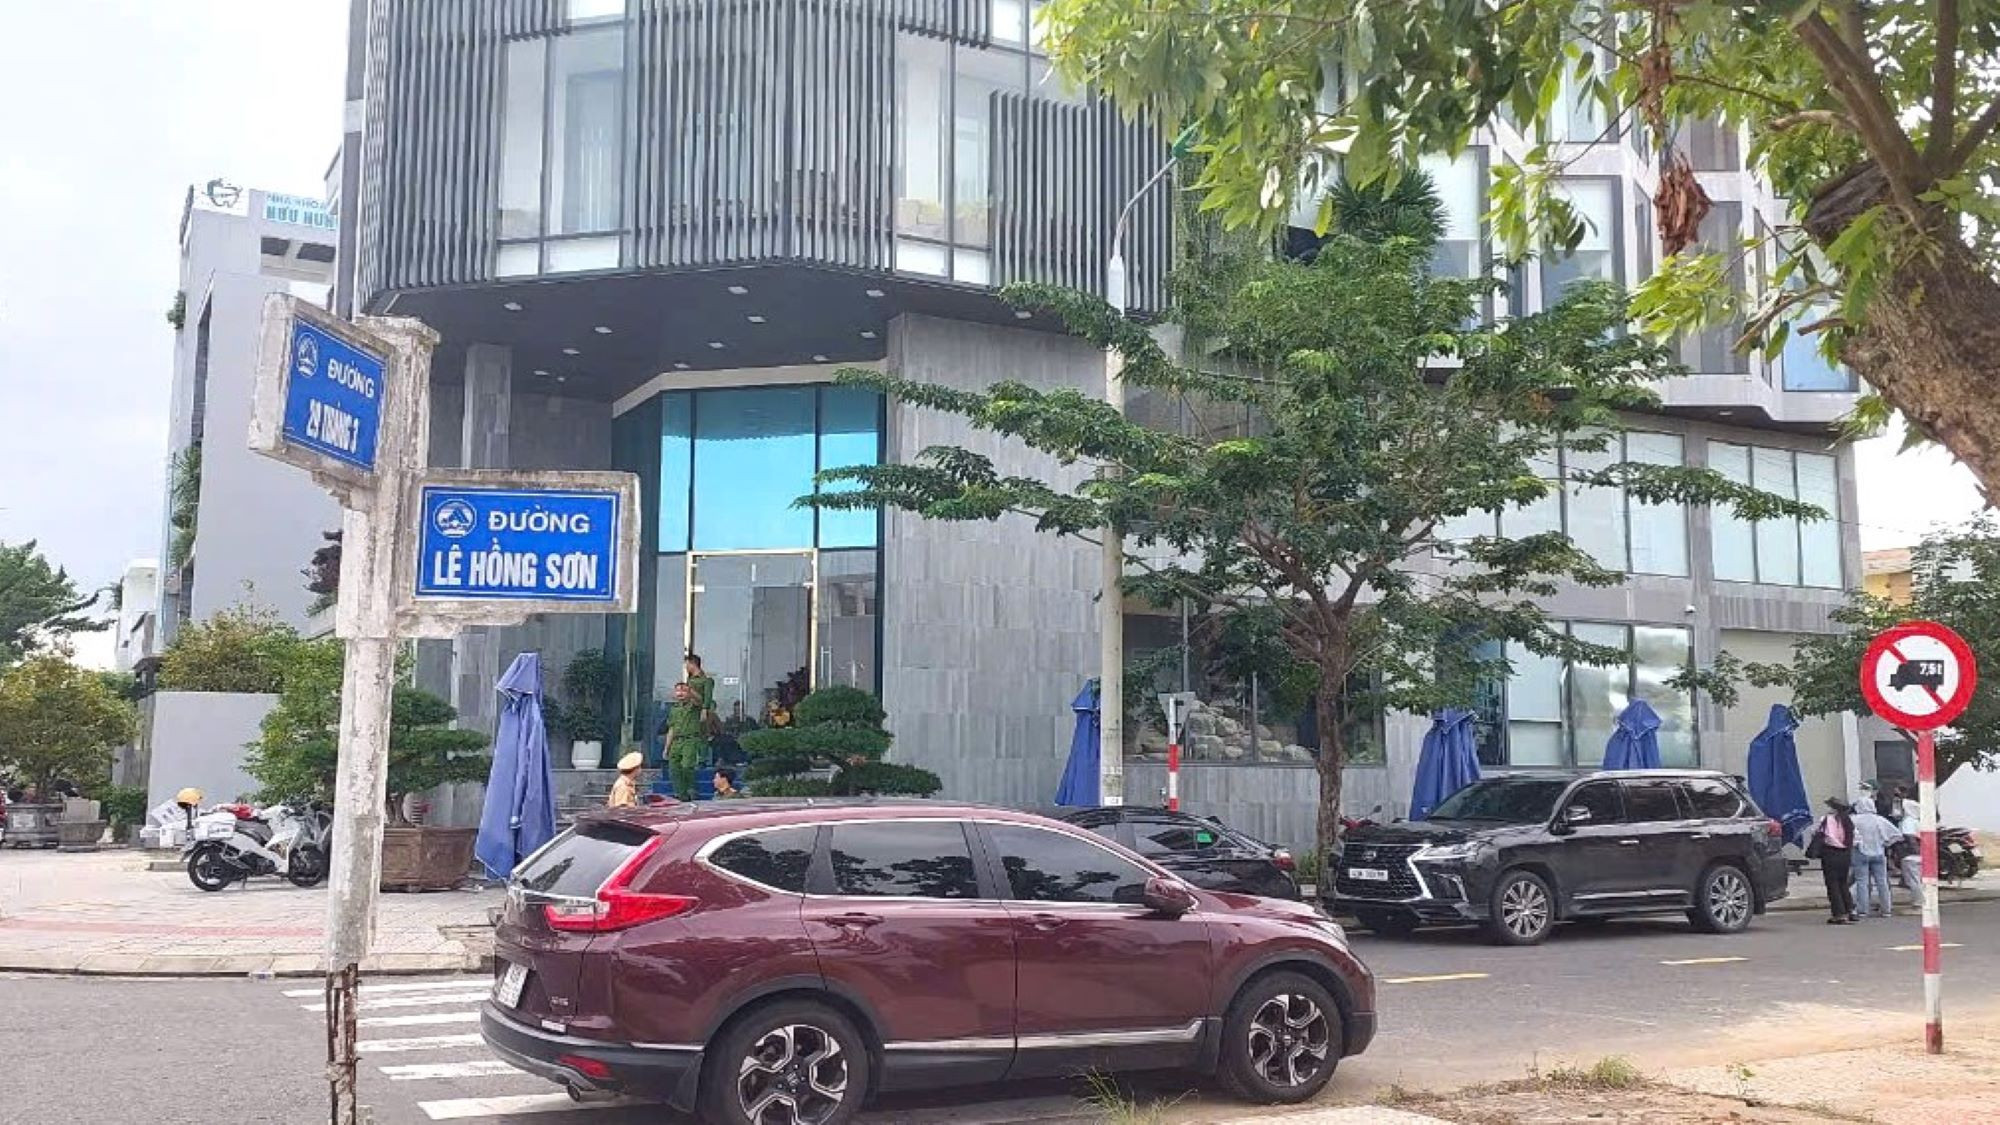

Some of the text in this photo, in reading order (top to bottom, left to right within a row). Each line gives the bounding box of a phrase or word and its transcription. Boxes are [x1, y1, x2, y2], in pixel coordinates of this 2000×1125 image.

[327, 358, 375, 398] ĐƯỜNG
[487, 504, 591, 533] ĐƯỜNG
[433, 536, 598, 590] LÊ HỒNG SƠN
